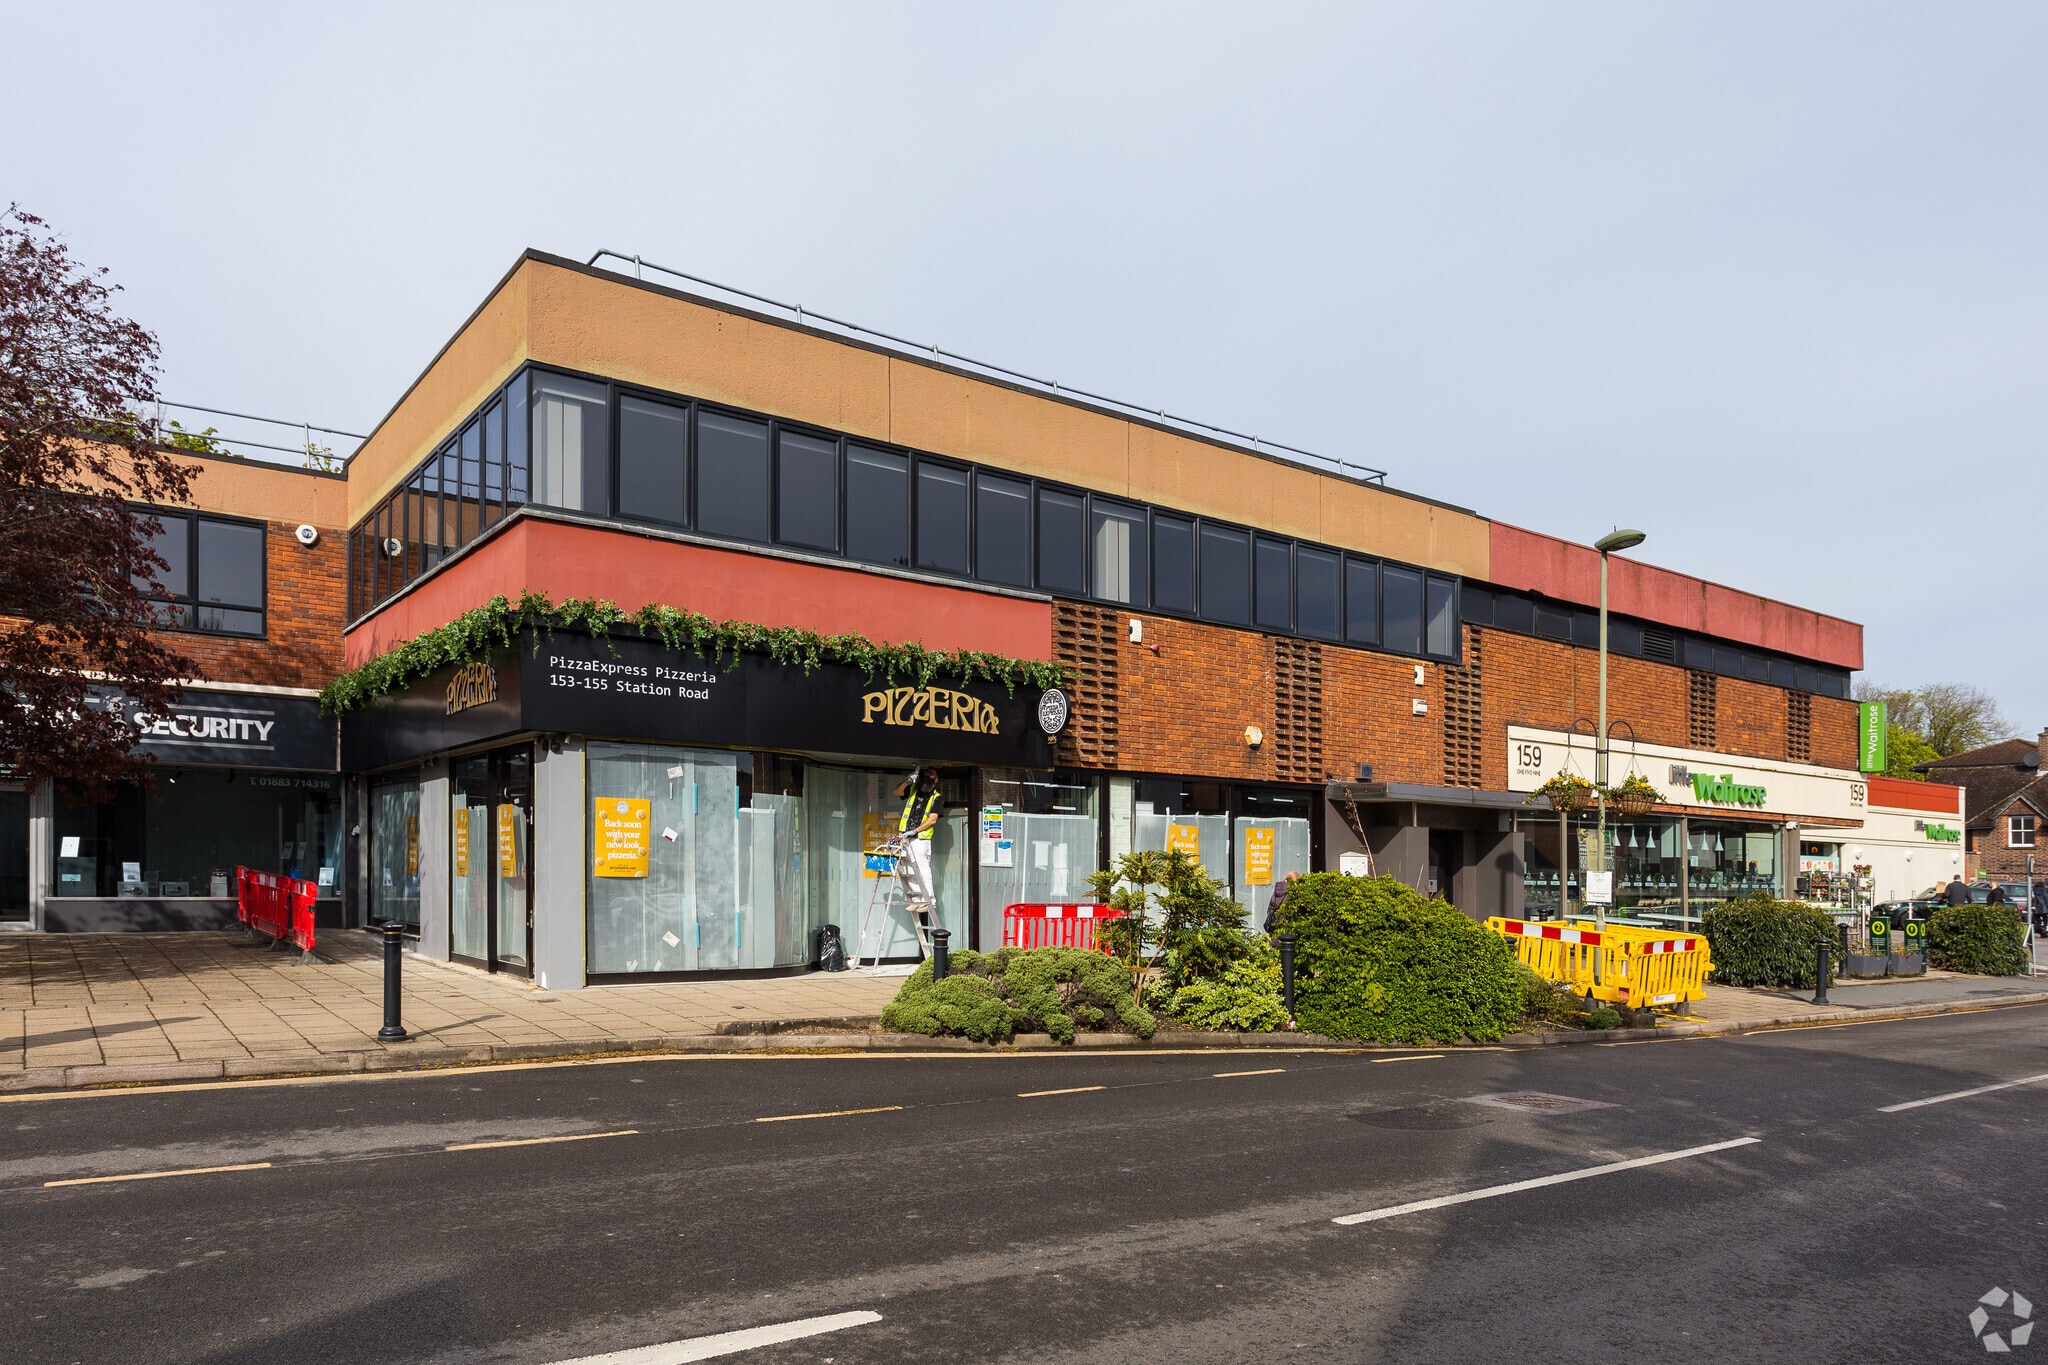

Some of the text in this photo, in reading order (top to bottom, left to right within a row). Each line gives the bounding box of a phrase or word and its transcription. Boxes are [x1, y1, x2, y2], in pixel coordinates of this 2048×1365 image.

[550, 655, 716, 683] PizzaExpress Pizzeria
[446, 662, 494, 715] PIZZERIA
[550, 674, 709, 700] 153-155 Station Road
[861, 686, 1000, 735] PIZZERIA
[133, 711, 275, 742] SECURITY
[1867, 705, 1878, 753] Waitrose
[1516, 744, 1542, 767] 159
[259, 777, 291, 787] 01883
[294, 779, 331, 789] 714316
[1692, 773, 1767, 804] Waitrose
[1850, 783, 1865, 802] 159
[604, 819, 623, 828] Back
[605, 829, 641, 841] with your
[606, 840, 639, 849] new look
[607, 850, 638, 861] pizzeria.
